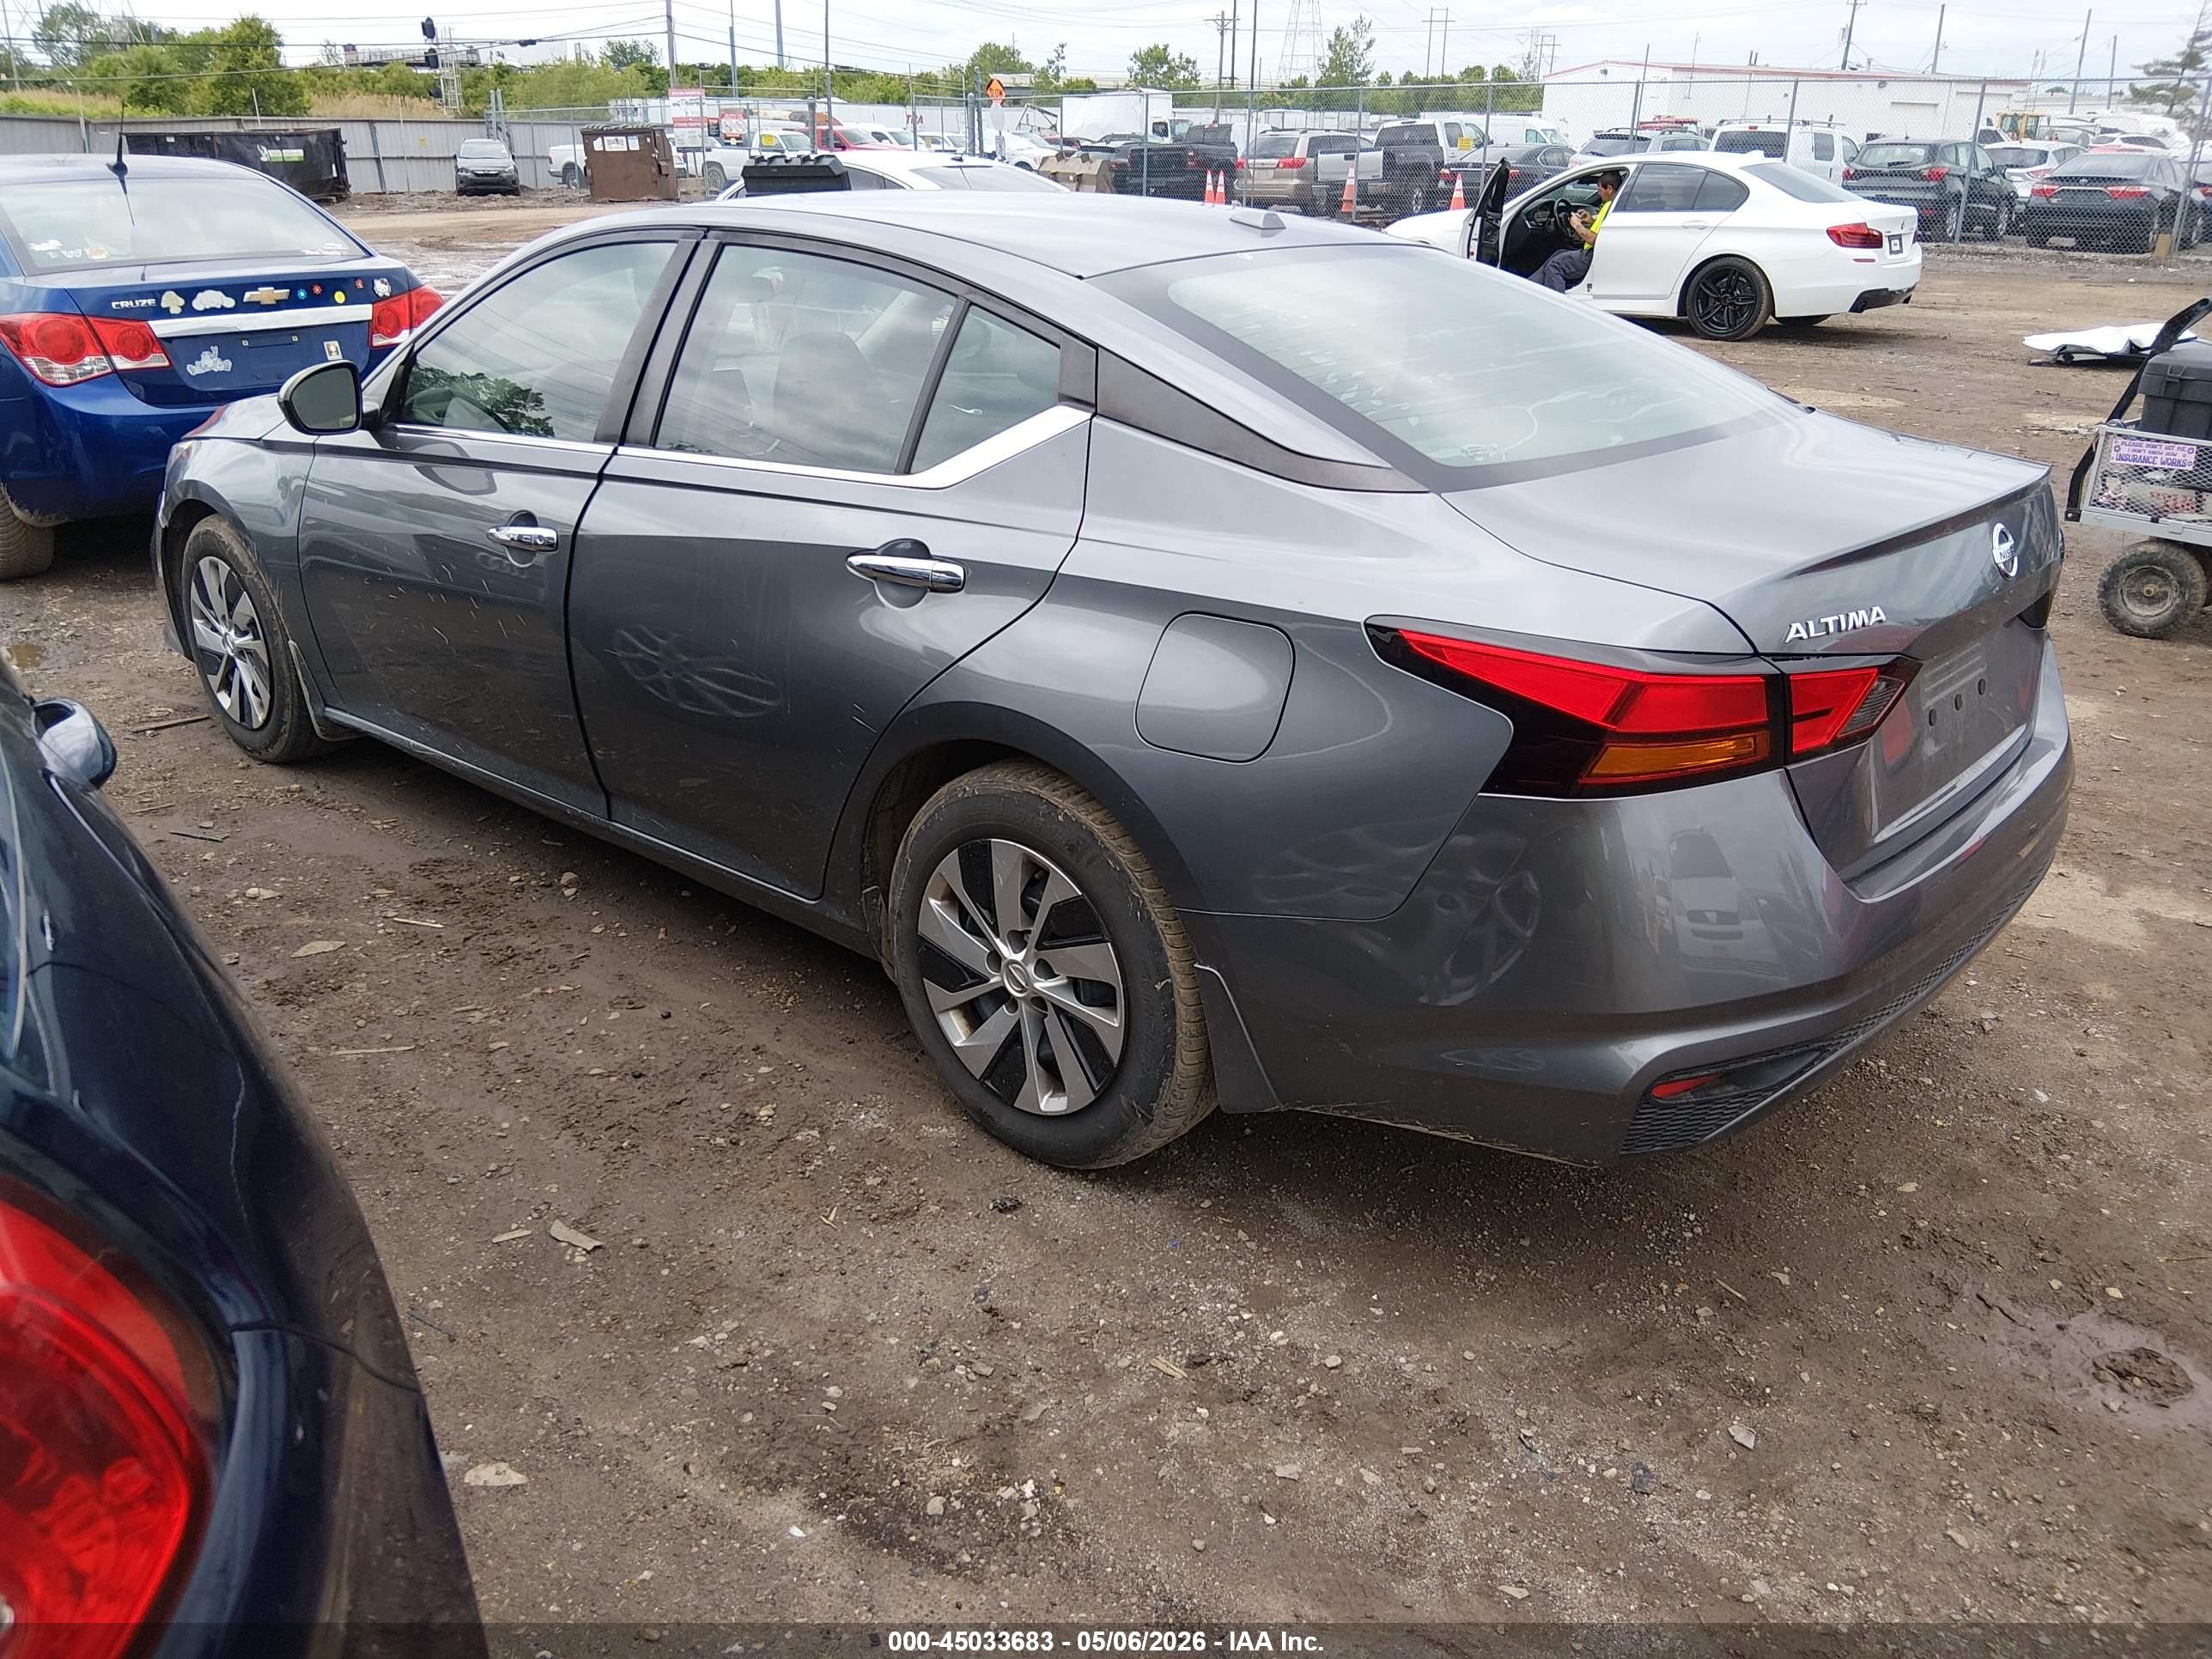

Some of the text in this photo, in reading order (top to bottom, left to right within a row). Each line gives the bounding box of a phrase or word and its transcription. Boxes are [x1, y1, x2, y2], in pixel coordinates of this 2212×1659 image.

[111, 299, 156, 309] CRUZE
[2115, 453, 2187, 467] INSURANCE WORKS
[1784, 605, 1887, 643] ALTIMA
